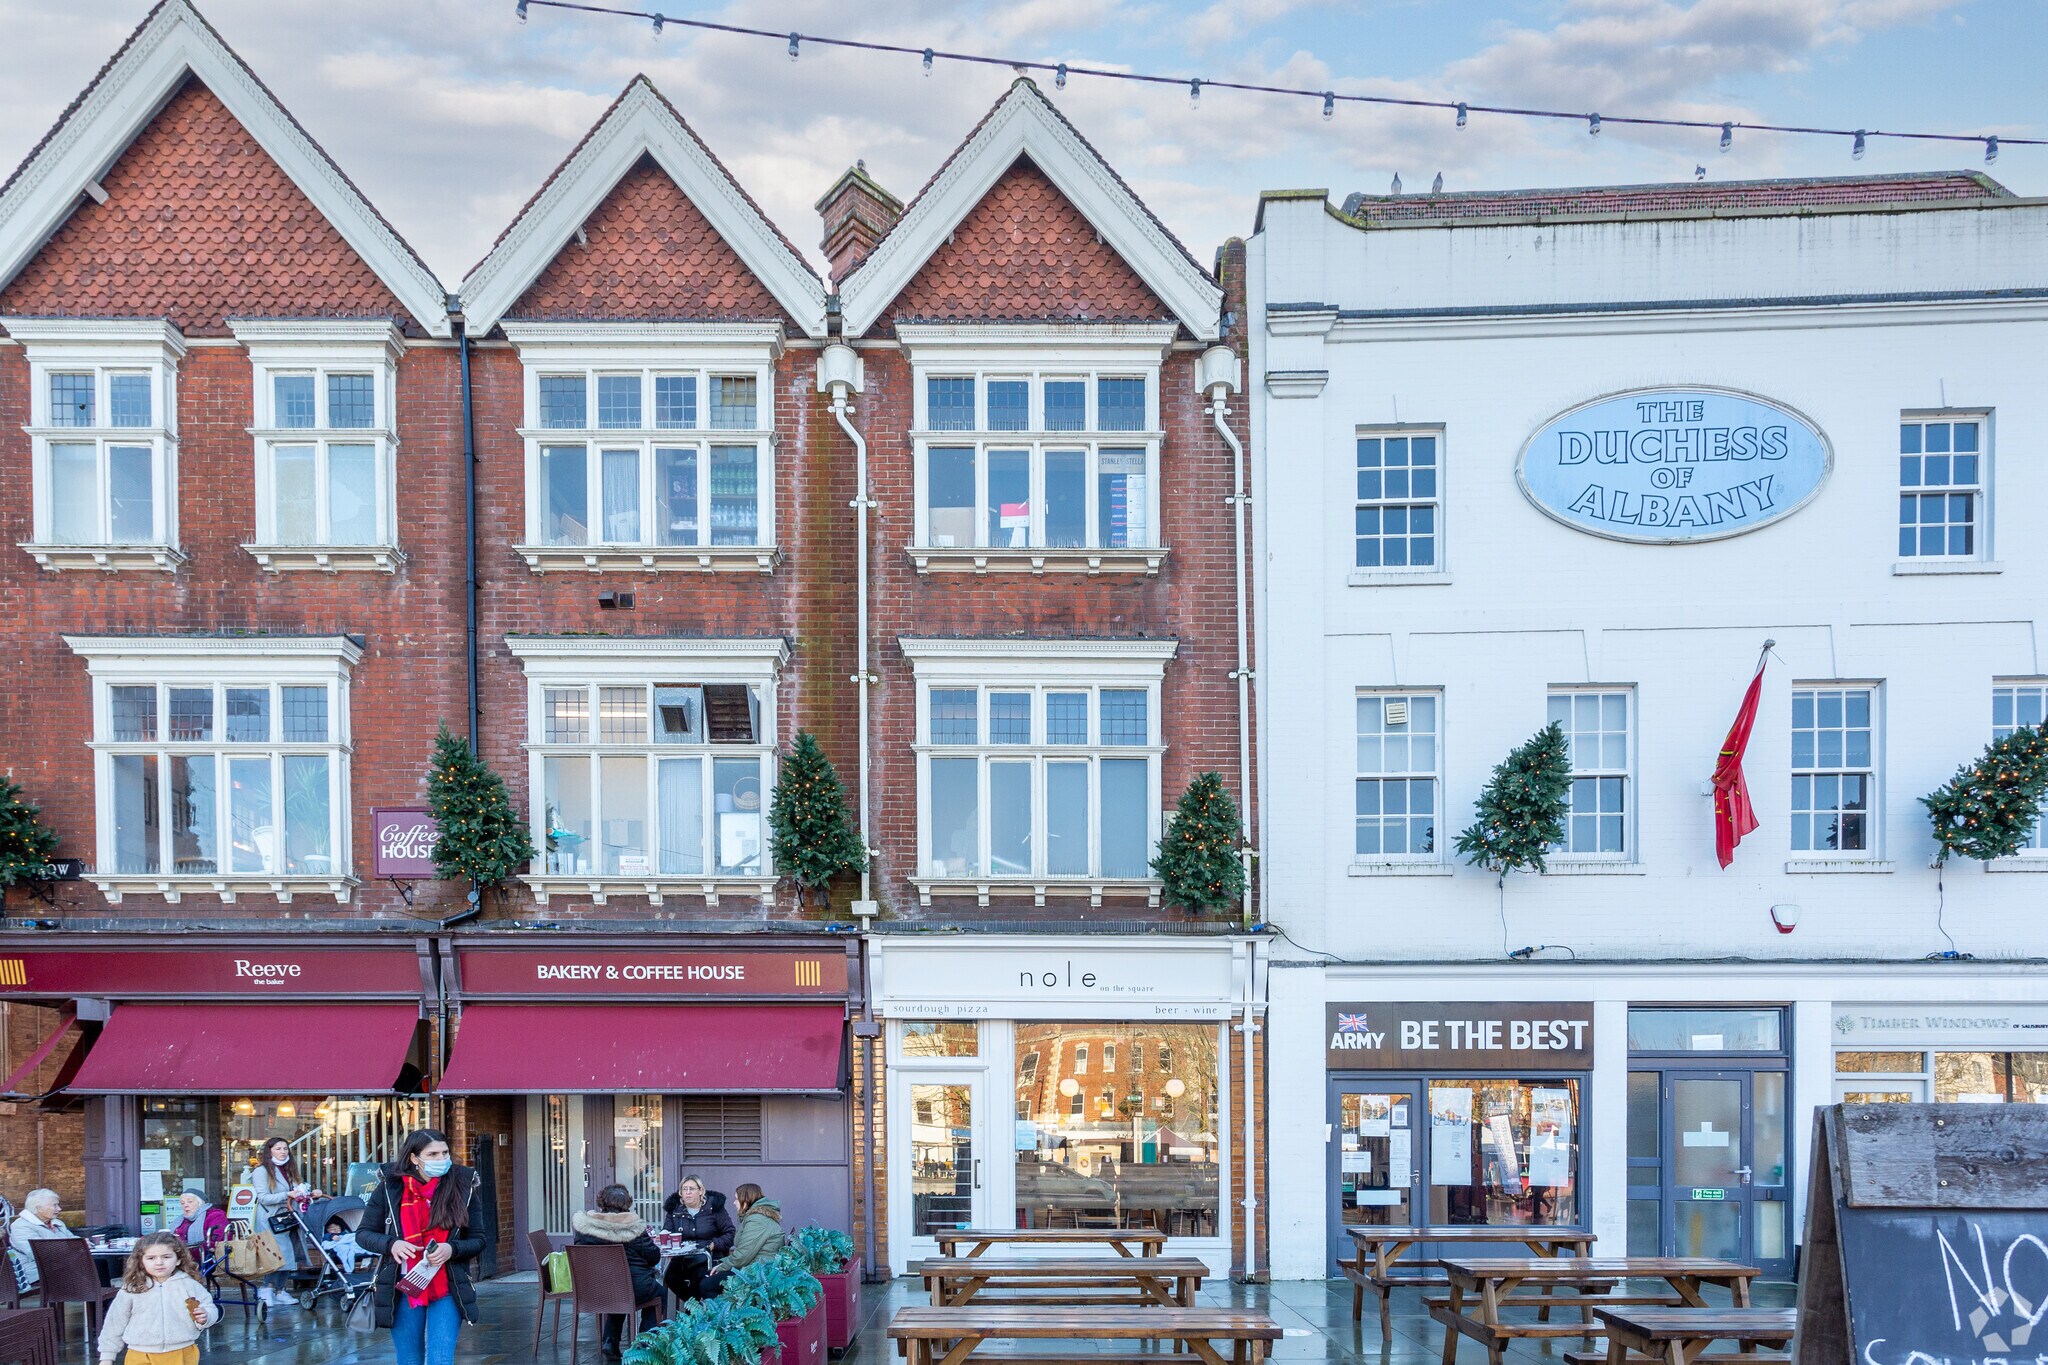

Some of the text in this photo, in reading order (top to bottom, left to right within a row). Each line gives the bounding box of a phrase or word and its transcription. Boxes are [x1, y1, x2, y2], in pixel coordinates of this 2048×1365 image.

[1637, 400, 1705, 423] THE
[1558, 426, 1789, 466] DUCHESS
[1650, 467, 1695, 489] OF
[1568, 474, 1775, 528] ALBANY
[380, 823, 441, 848] Coffee
[45, 863, 70, 876] OW
[233, 959, 302, 977] Reeve
[537, 964, 745, 980] BAKERY & COFFEE HOUSE
[1020, 960, 1097, 988] nole
[1112, 984, 1125, 992] the
[1127, 986, 1154, 994] square
[893, 1004, 988, 1015] sourdough pizza
[1155, 1005, 1179, 1014] beer
[1193, 1006, 1218, 1014] wine
[1330, 1032, 1385, 1050] ARMY
[1400, 1019, 1589, 1050] BE THE BEST
